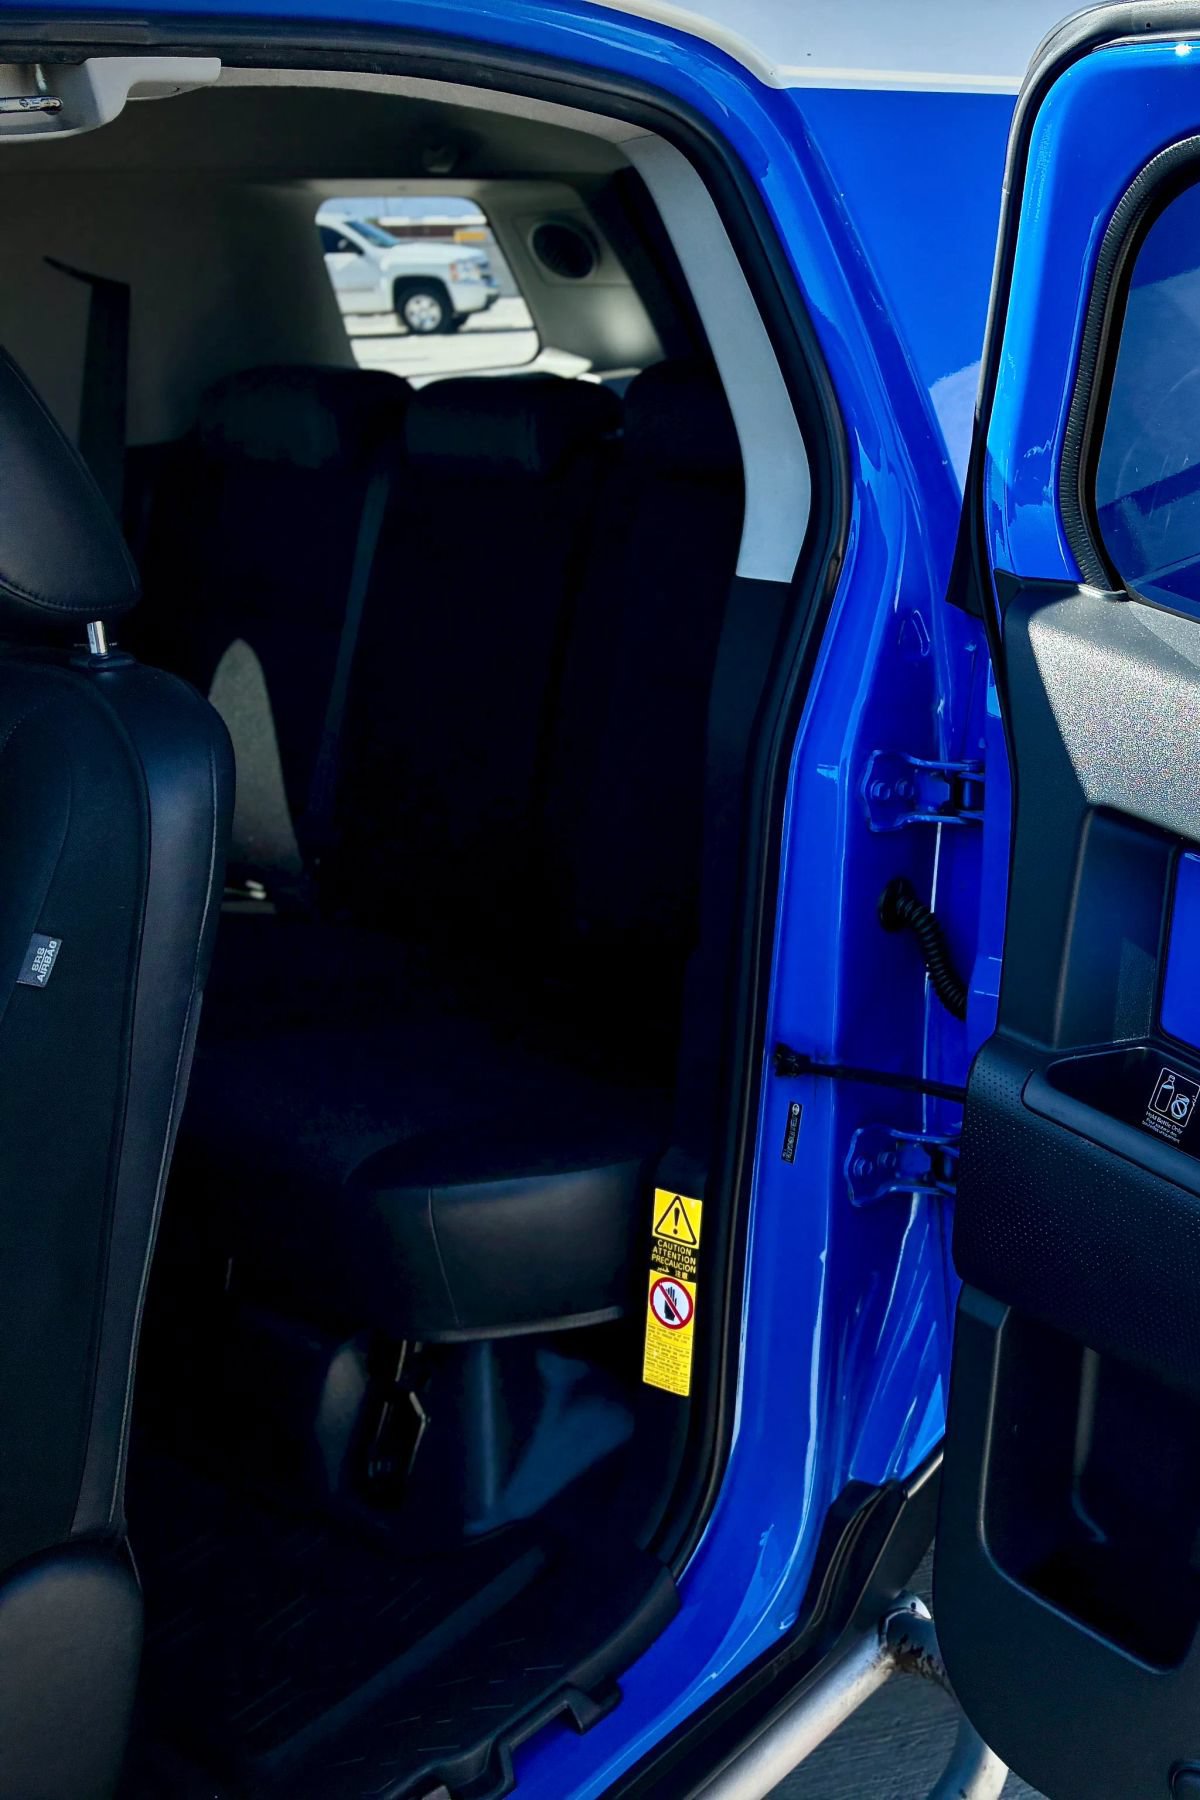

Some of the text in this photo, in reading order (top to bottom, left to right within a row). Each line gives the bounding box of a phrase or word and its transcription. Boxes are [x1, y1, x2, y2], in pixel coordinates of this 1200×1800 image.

[32, 947, 45, 971] SRS
[37, 940, 57, 983] AIRBAG
[1171, 1124, 1183, 1135] Only
[652, 1245, 697, 1265] ATTENTION
[657, 1239, 692, 1256] CAUTION
[651, 1253, 697, 1274] PRECAUCION
